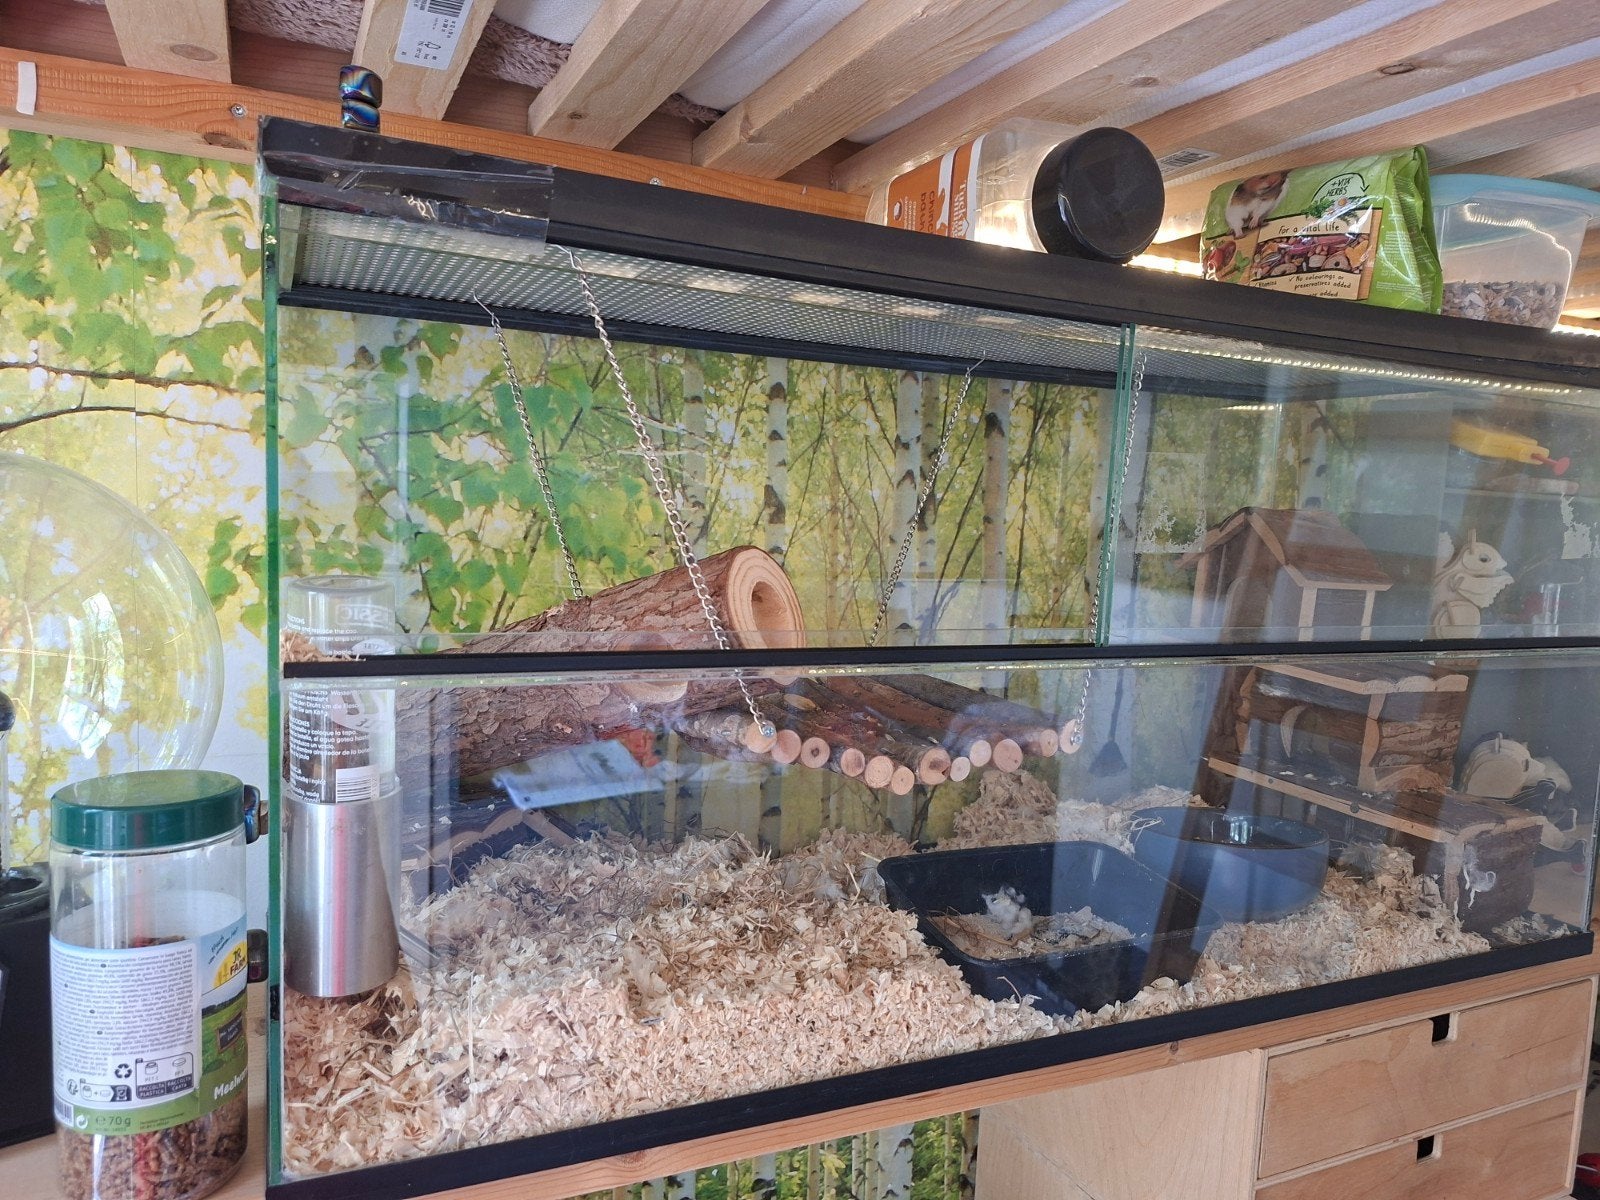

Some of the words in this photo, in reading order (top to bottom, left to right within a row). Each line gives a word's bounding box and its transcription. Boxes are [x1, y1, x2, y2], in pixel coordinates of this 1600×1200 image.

[1326, 186, 1348, 197] HERBS
[927, 191, 935, 233] chinc
[1325, 222, 1340, 232] life
[1294, 280, 1331, 290] preservatives
[1333, 281, 1352, 289] added
